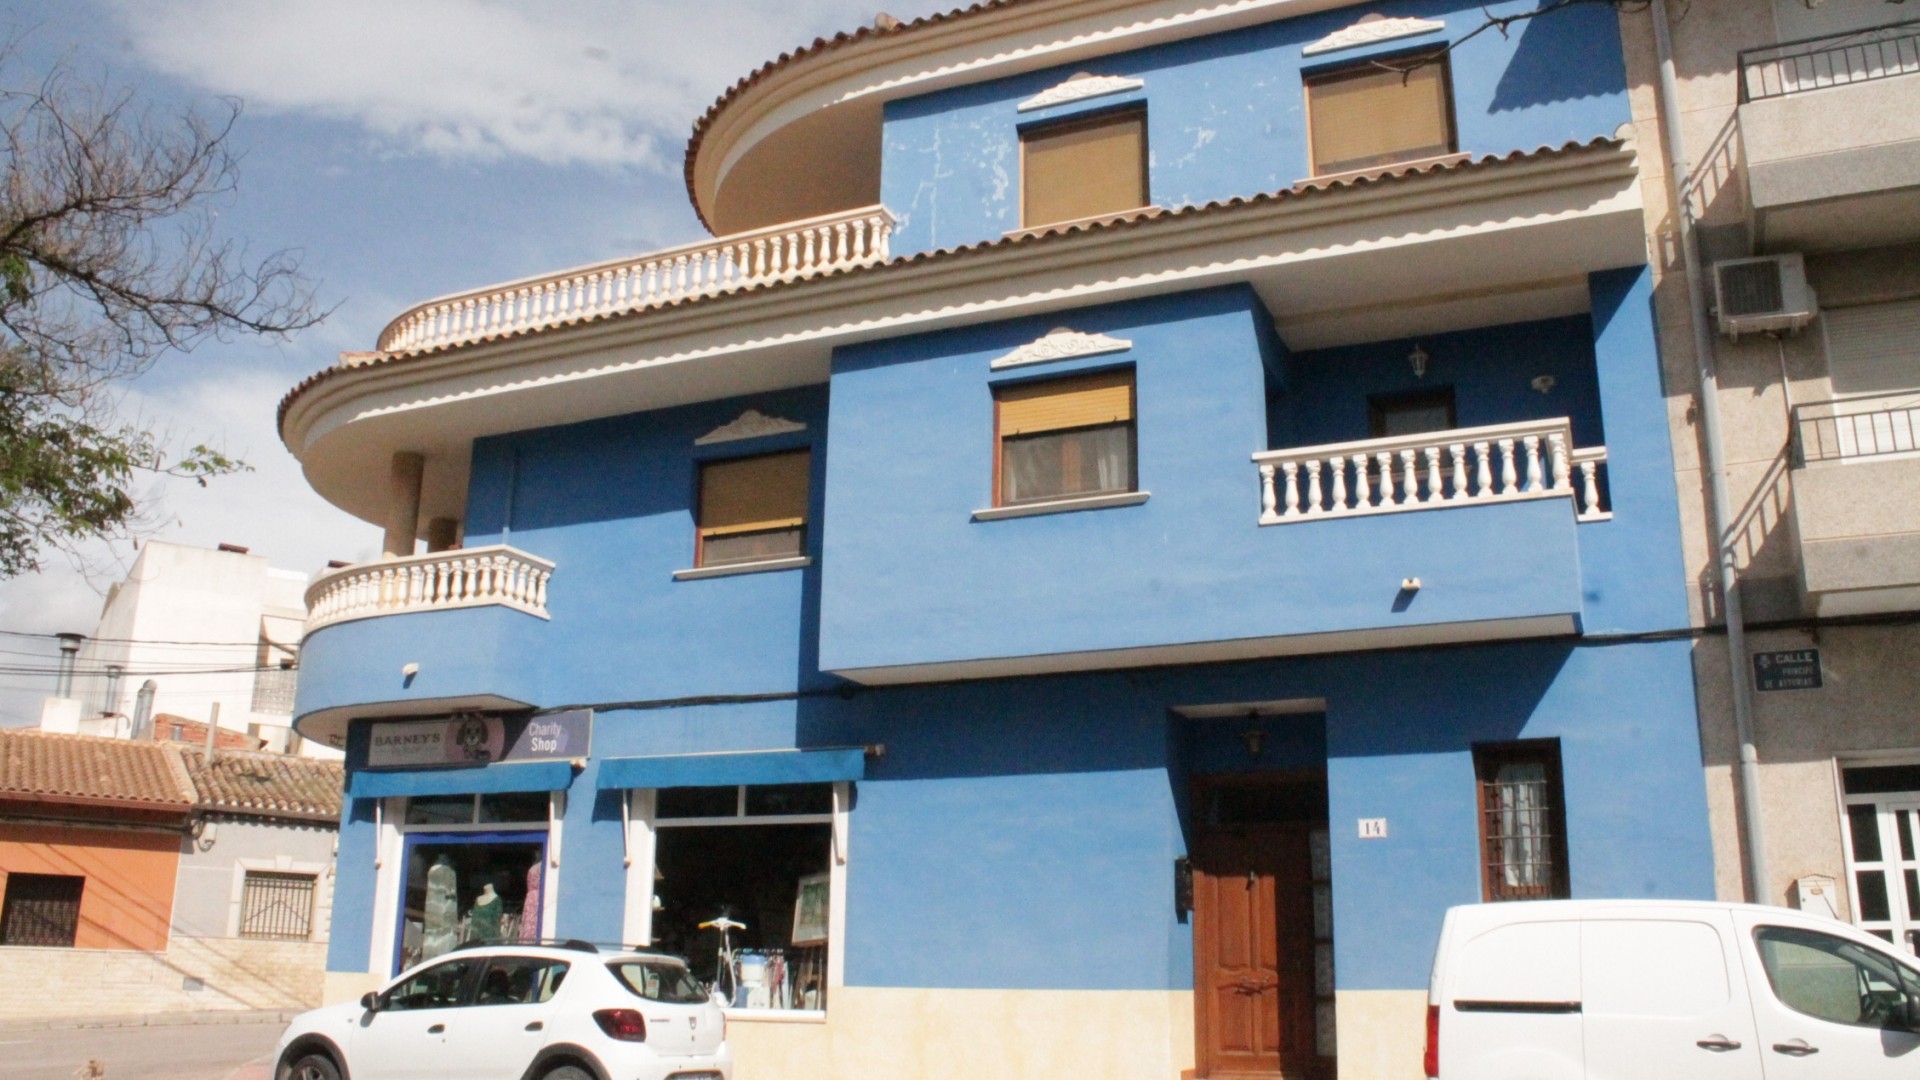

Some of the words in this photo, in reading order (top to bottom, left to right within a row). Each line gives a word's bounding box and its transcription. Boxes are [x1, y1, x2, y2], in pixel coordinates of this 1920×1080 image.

[1775, 652, 1813, 664] CALLE
[529, 722, 562, 738] Charity
[375, 733, 441, 746] BARNEY'S
[531, 737, 557, 753] Shop
[1365, 821, 1380, 835] 14
